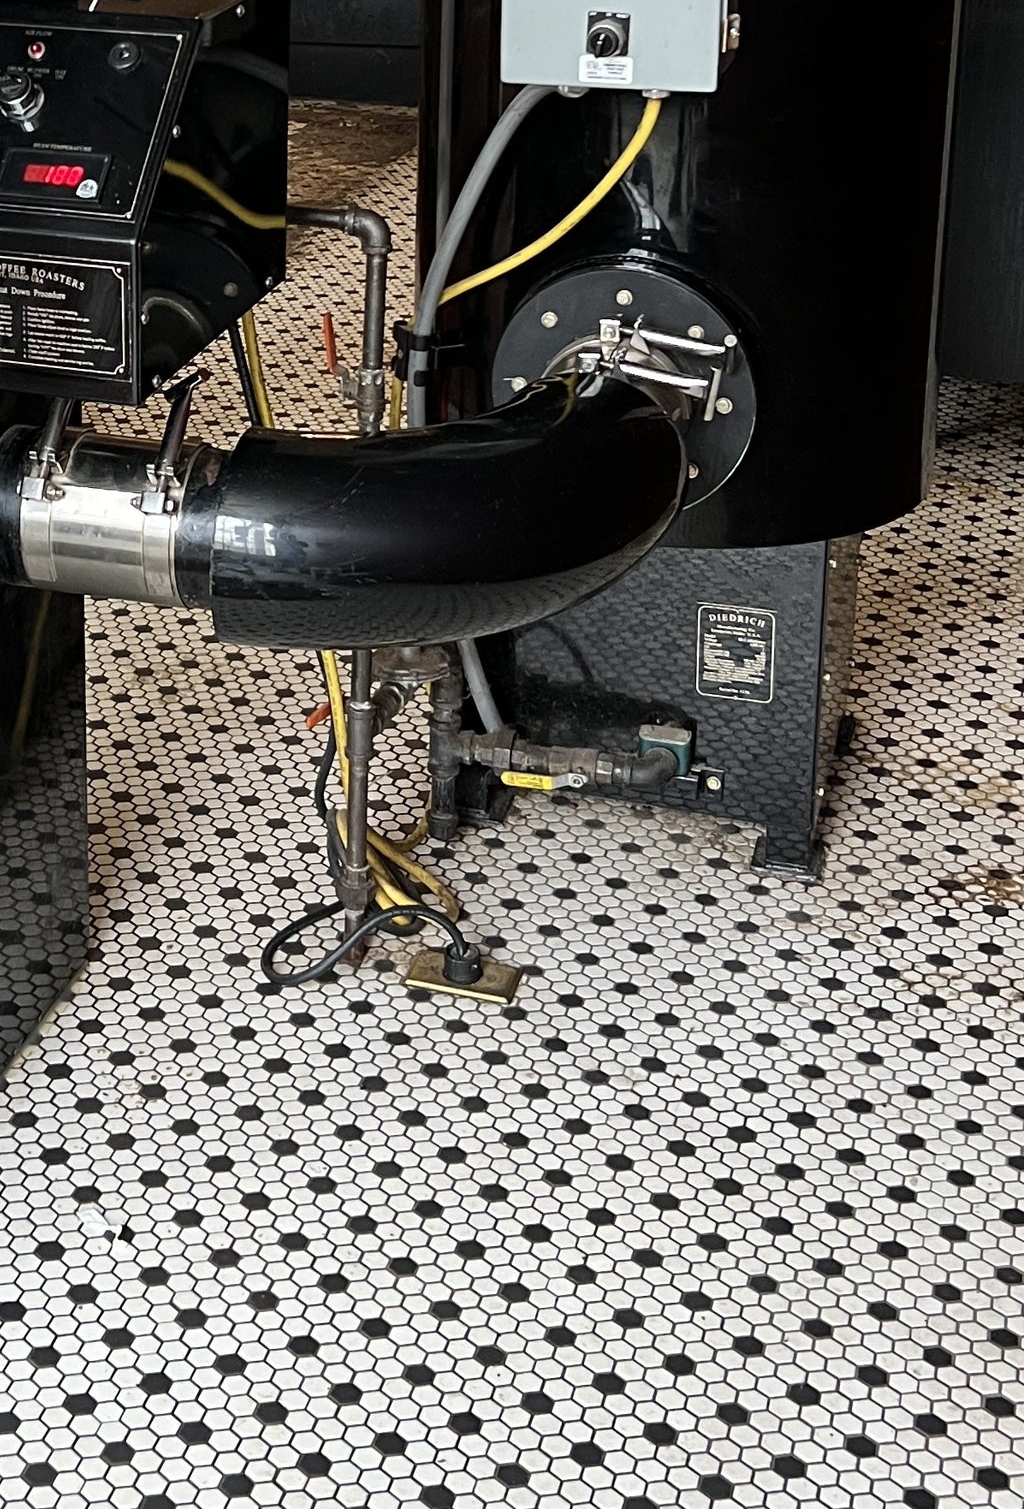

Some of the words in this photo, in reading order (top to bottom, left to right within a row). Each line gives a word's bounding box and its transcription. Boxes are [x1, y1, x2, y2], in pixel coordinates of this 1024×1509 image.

[31, 267, 86, 291] ROASTERS
[11, 286, 30, 296] Down
[708, 613, 766, 628] DIEDRICH
